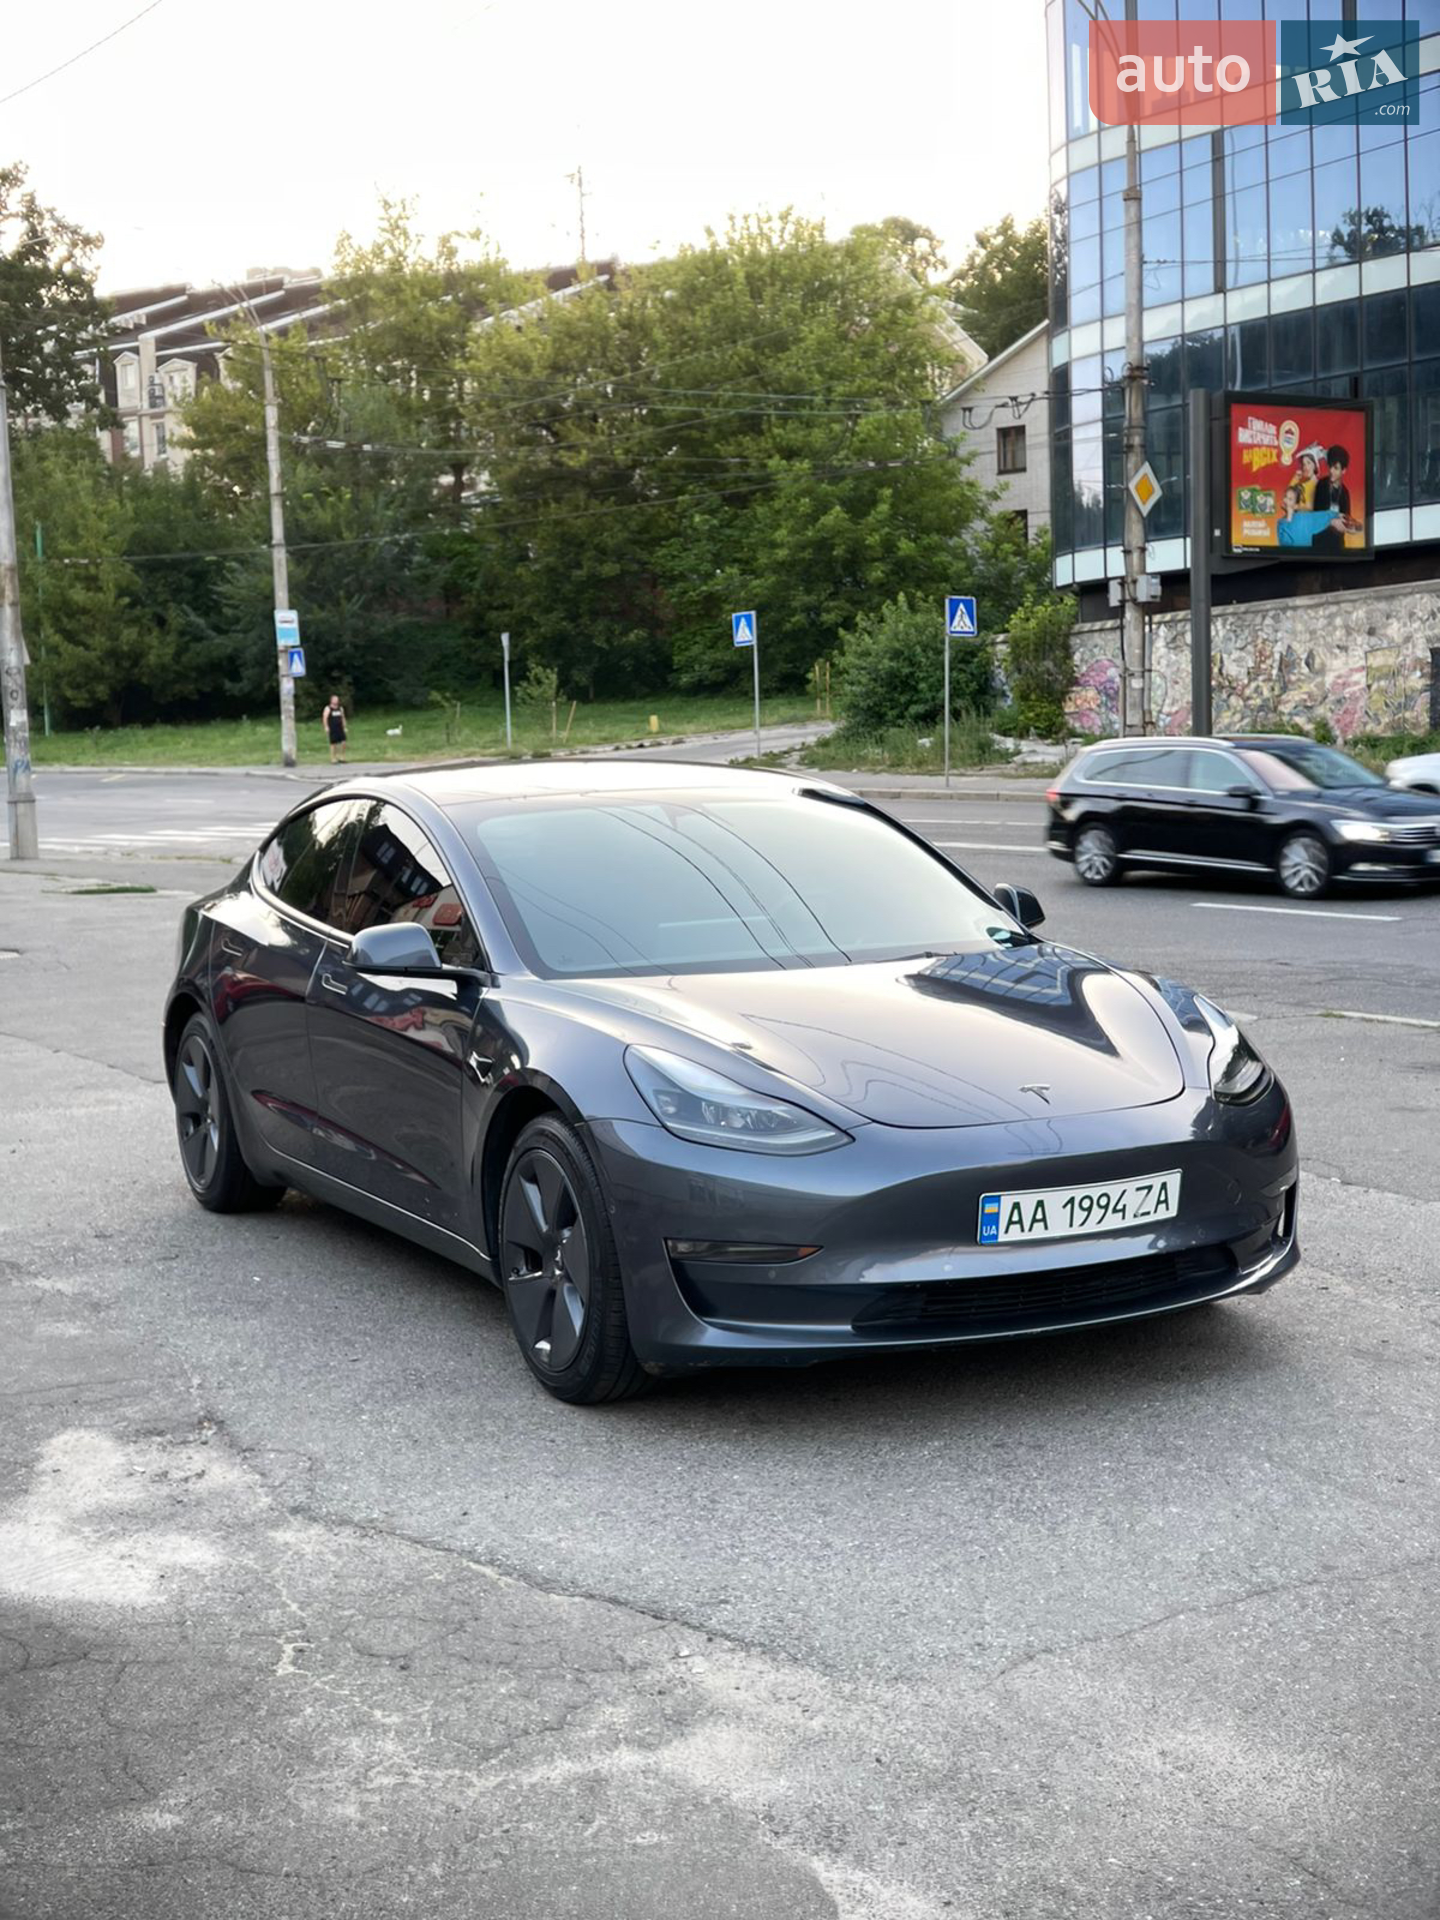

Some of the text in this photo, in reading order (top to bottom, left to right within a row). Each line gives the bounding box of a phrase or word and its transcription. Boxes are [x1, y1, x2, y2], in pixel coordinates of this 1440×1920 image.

[1004, 1181, 1170, 1235] AA 1994 ZA
[982, 1226, 998, 1237] UA
